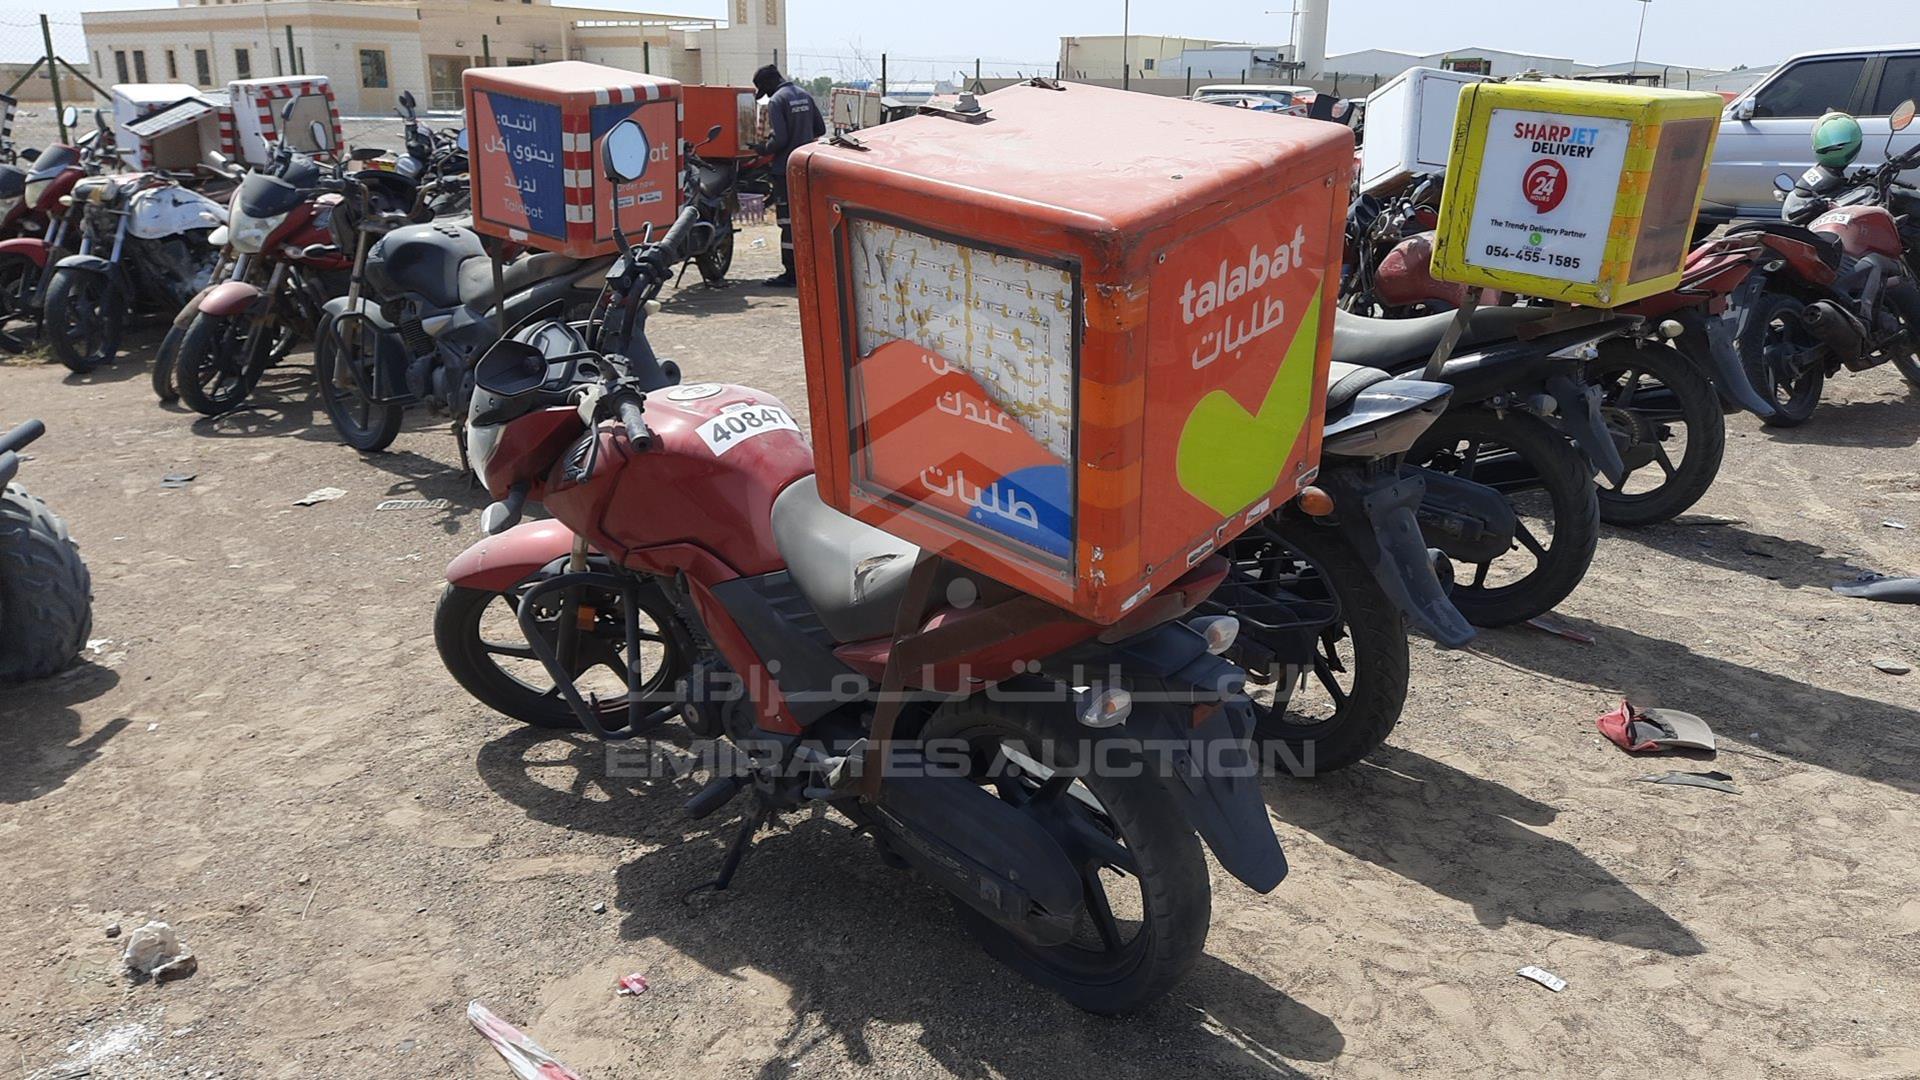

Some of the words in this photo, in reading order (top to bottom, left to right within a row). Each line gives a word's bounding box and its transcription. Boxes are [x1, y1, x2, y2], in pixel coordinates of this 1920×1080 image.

[496, 113, 538, 134] انتبه:
[484, 134, 511, 154] أكل
[512, 142, 555, 169] يحتوي
[1531, 141, 1595, 159] DELIVERY
[503, 170, 537, 195] لذيذ
[1532, 176, 1557, 197] 24
[503, 197, 544, 220] Talabat
[1490, 218, 1504, 228] The
[1504, 220, 1528, 232] Trendy
[1529, 224, 1559, 236] Delivery
[1559, 228, 1587, 239] Partner
[1485, 244, 1581, 270] 054-455-1585
[1178, 224, 1305, 325] talabat
[1191, 294, 1285, 370] طلبات
[936, 391, 1013, 434] عندك
[712, 407, 788, 444] 40847
[920, 465, 1039, 530] طلبات
